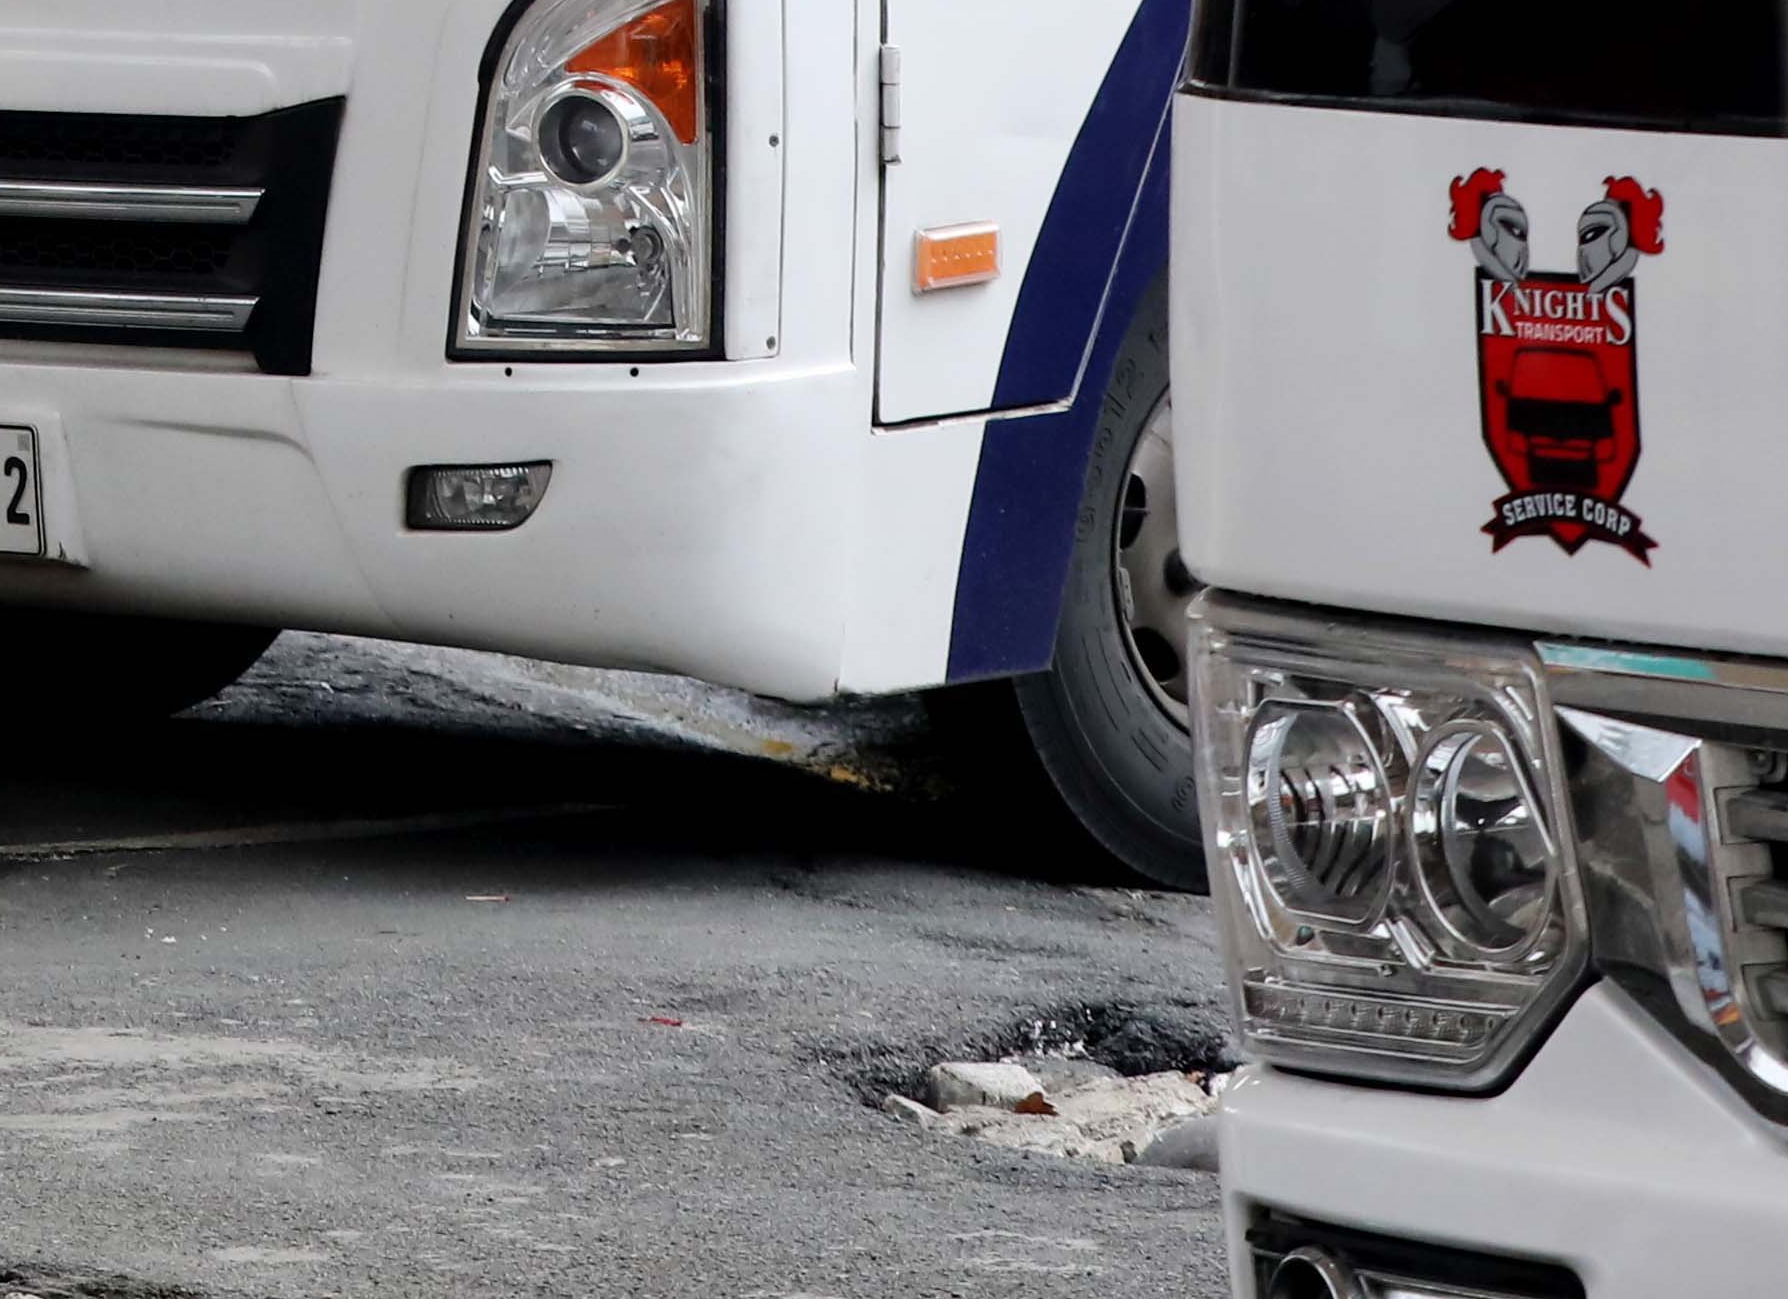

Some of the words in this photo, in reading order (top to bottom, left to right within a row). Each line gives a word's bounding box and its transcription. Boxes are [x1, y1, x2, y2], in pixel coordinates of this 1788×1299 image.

[1480, 278, 1632, 346] KNIGHTS
[1514, 320, 1605, 344] TRANSPORT
[1502, 491, 1576, 526] SERVICE
[1582, 498, 1632, 536] CORP
